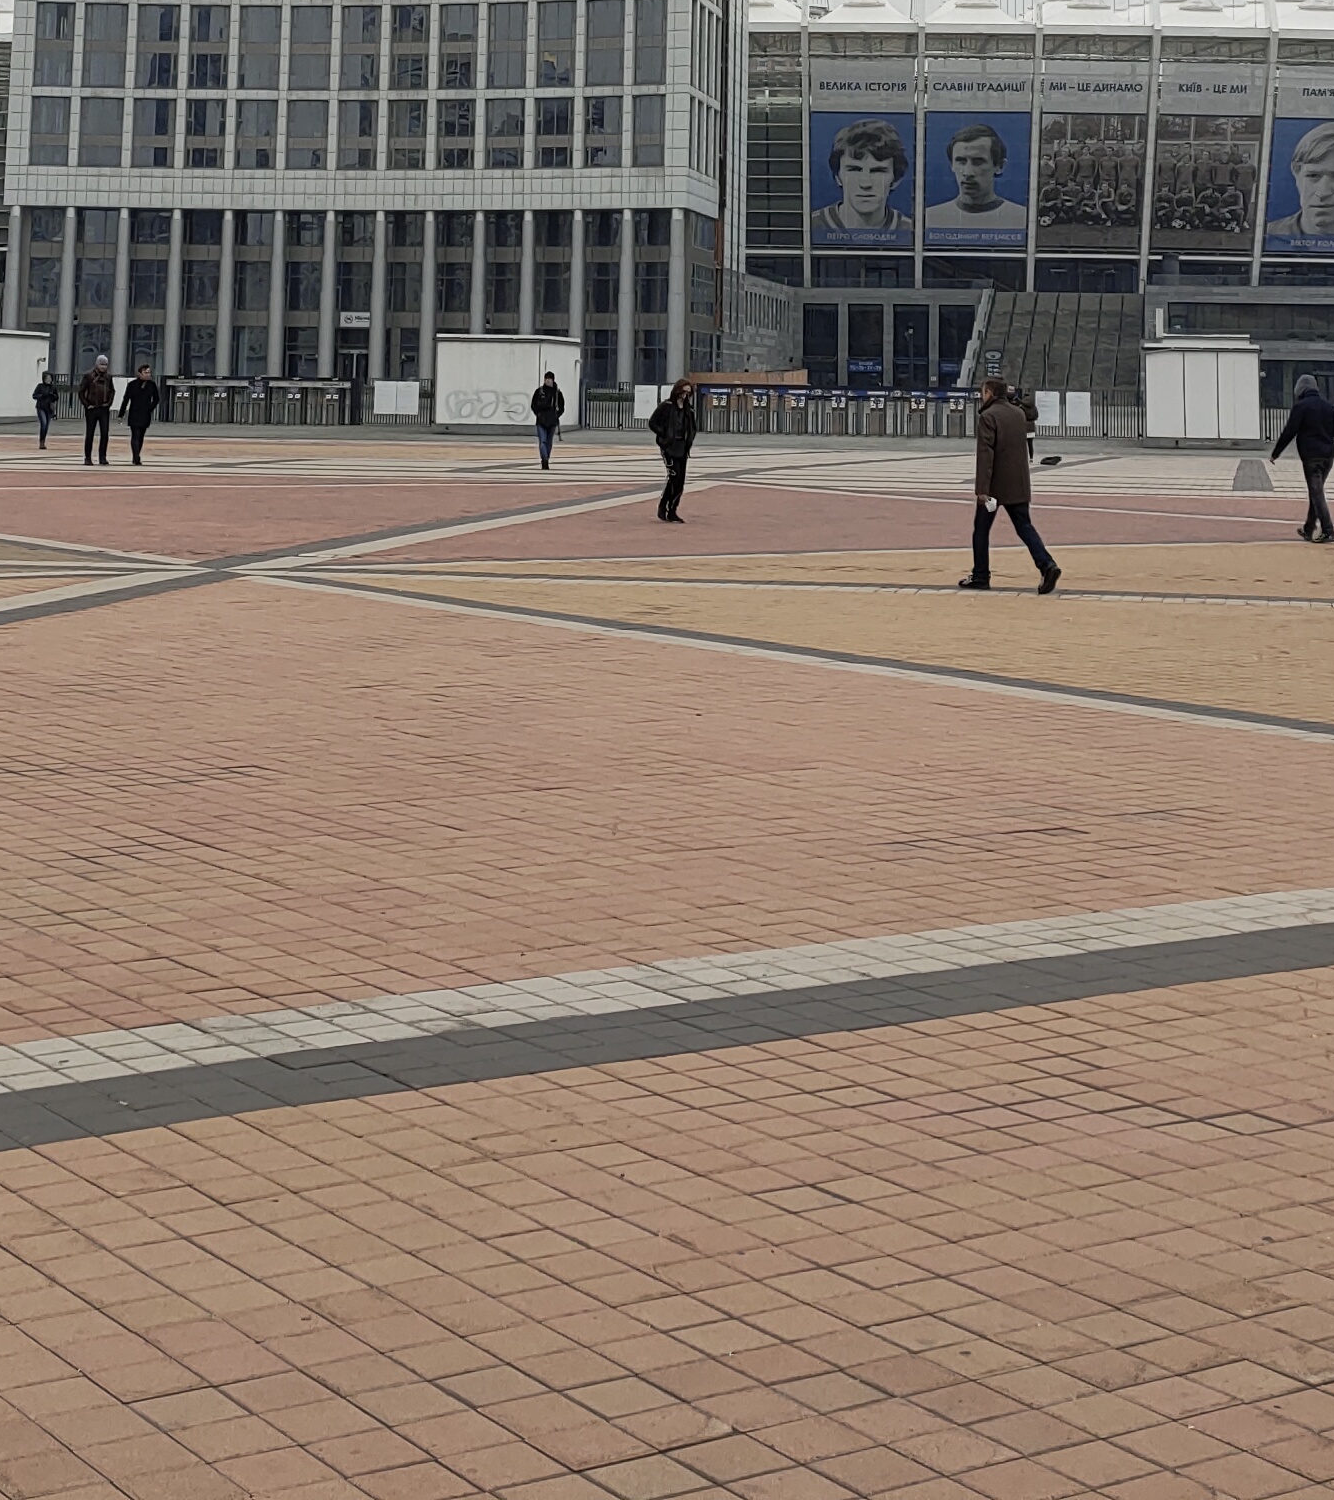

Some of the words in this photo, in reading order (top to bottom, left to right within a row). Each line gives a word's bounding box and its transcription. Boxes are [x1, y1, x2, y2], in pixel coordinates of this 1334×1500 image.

[819, 81, 862, 91] ВЕЛИКА
[865, 82, 907, 92] ІСТОРІЯ
[933, 82, 974, 92] СЛАВНІ
[976, 81, 1026, 93] ТРАДИЦІЇ
[1049, 82, 1067, 92] МИ
[1077, 82, 1092, 94] ЦЕ
[1092, 83, 1143, 93] ДИНАМО
[1178, 83, 1202, 93] КИЇВ
[1213, 84, 1227, 94] ЦЕ
